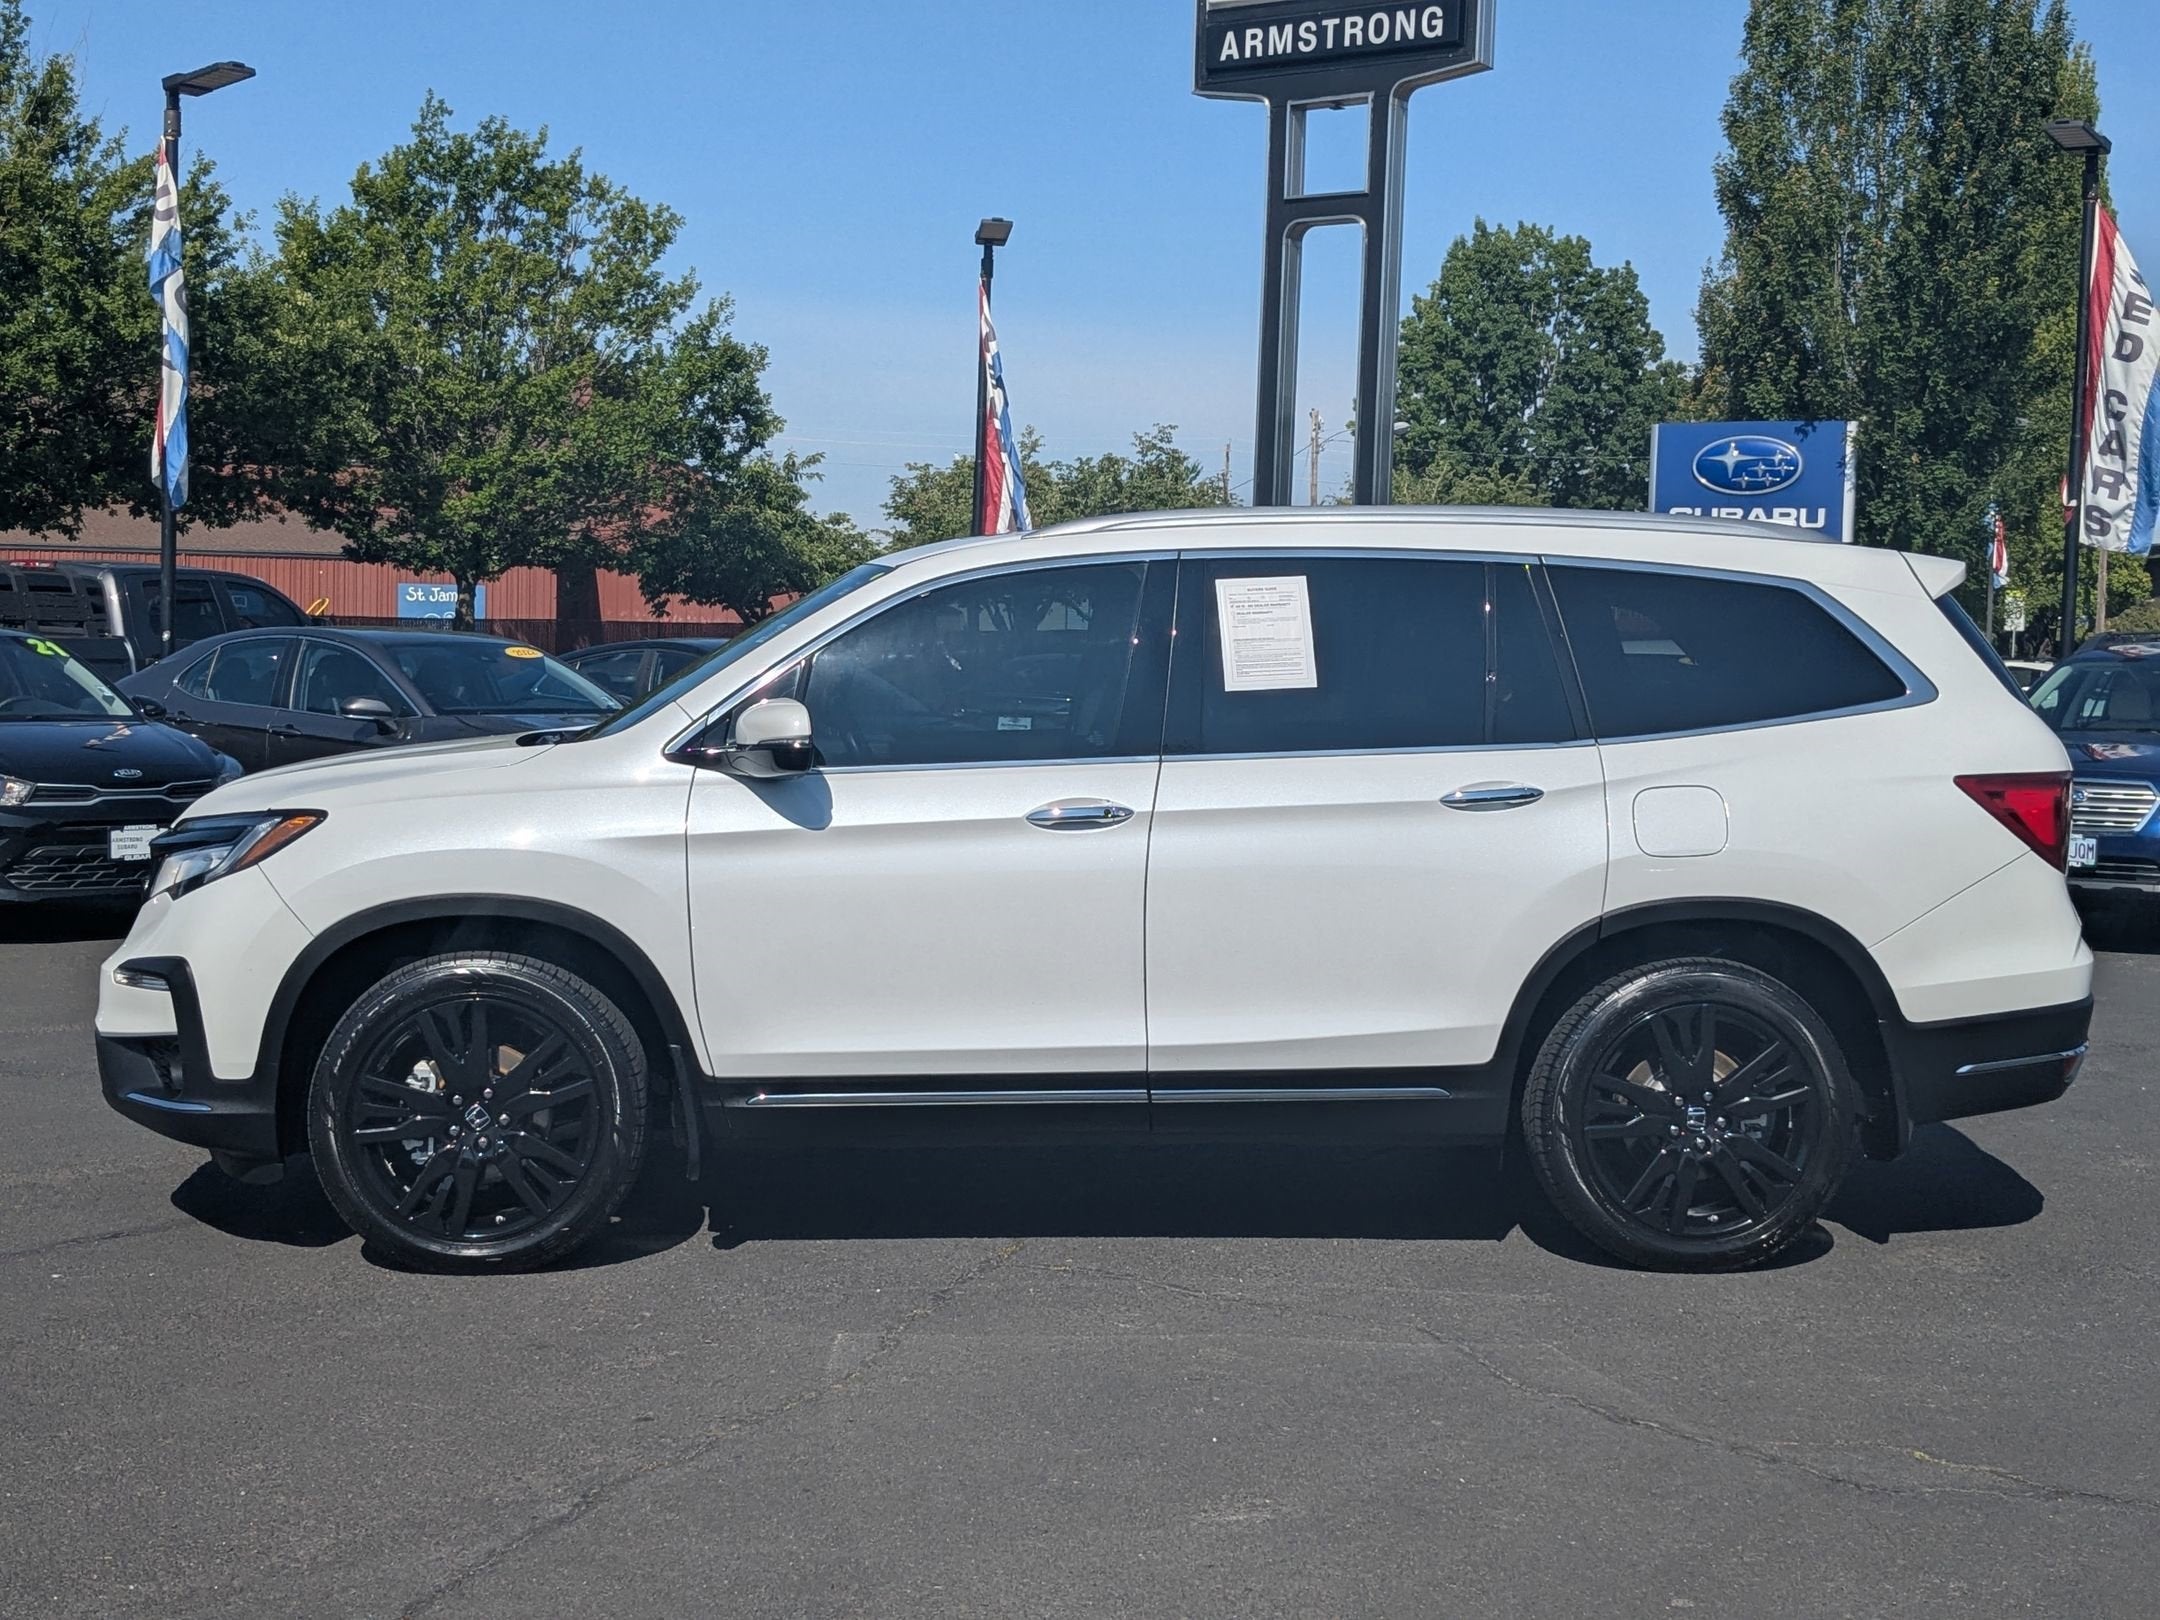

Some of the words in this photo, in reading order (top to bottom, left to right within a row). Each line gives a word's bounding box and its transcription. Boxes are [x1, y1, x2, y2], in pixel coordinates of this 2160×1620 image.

[1219, 5, 1445, 62] ARMSTRONG
[2085, 388, 2131, 538] CARS
[428, 586, 458, 603] Jam
[26, 637, 71, 658] 21
[2069, 842, 2095, 860] JQM
